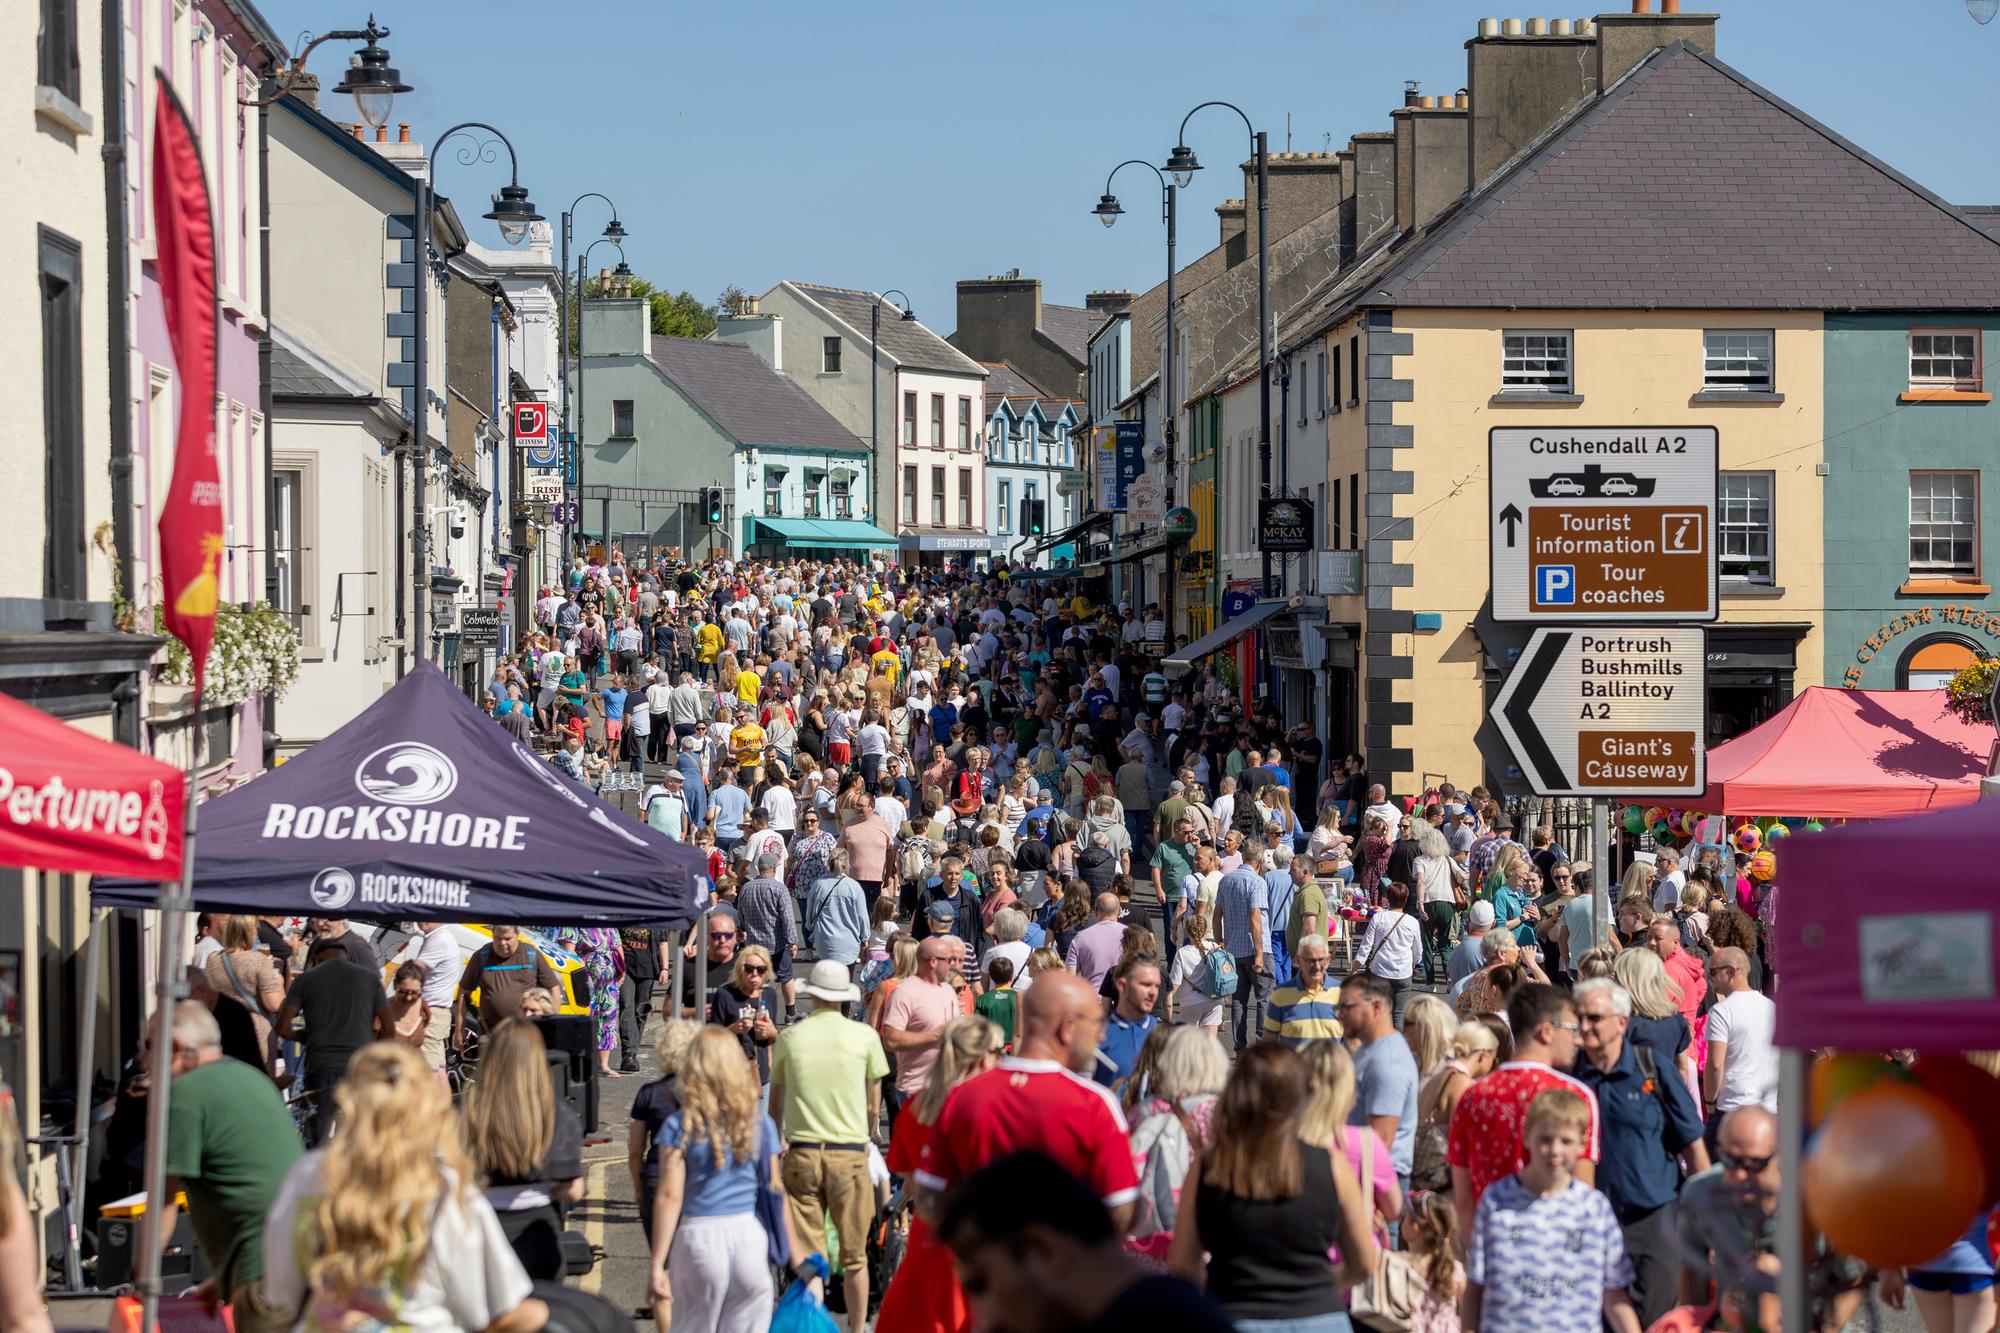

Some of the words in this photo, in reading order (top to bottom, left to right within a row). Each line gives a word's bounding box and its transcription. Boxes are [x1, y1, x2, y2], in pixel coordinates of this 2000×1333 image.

[1529, 437, 1648, 454] Cushendall
[1656, 437, 1687, 454] A2
[532, 486, 561, 494] IRISH
[1560, 513, 1631, 531] Tourist
[1263, 527, 1306, 538] McKAY
[936, 538, 967, 548] STEWARTS
[969, 538, 991, 548] SPORTS
[1536, 536, 1655, 554] information
[1601, 564, 1646, 581] Tour
[1546, 570, 1569, 601] P
[1582, 587, 1665, 604] coaches
[463, 612, 500, 626] Cobwebs
[1857, 606, 1933, 664] CELLAR
[1581, 636, 1672, 653] Portrush
[1581, 659, 1683, 675] Bushmills
[1581, 681, 1674, 700] Ballintoy
[1580, 703, 1611, 719] A2
[1601, 738, 1673, 756] Giant's
[1586, 760, 1688, 782] Causeway
[261, 803, 531, 851] ROCKSHORE
[360, 872, 472, 908] ROCKSHORE
